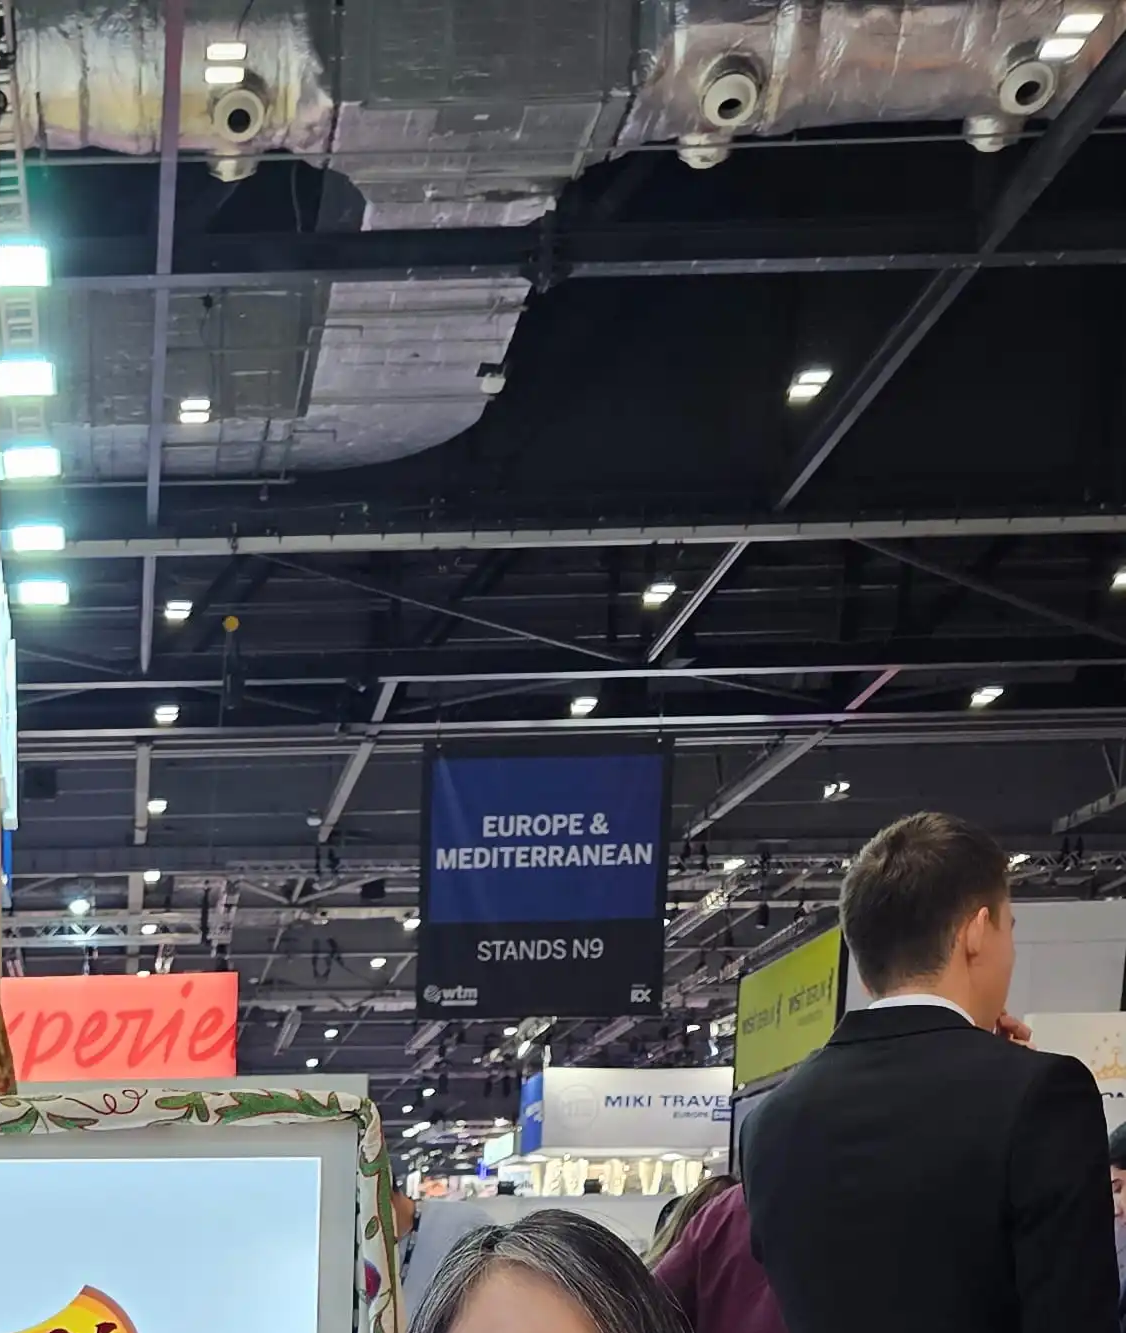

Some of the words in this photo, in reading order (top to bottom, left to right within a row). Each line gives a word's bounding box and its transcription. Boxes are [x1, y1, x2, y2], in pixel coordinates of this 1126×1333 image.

[482, 814, 584, 838] EUROPE
[589, 812, 610, 835] &
[435, 843, 653, 870] MEDITERRANEAN
[477, 940, 567, 962] STANDS
[572, 938, 604, 960] N9
[9, 980, 236, 1080] perie
[604, 1095, 652, 1108] MIKI
